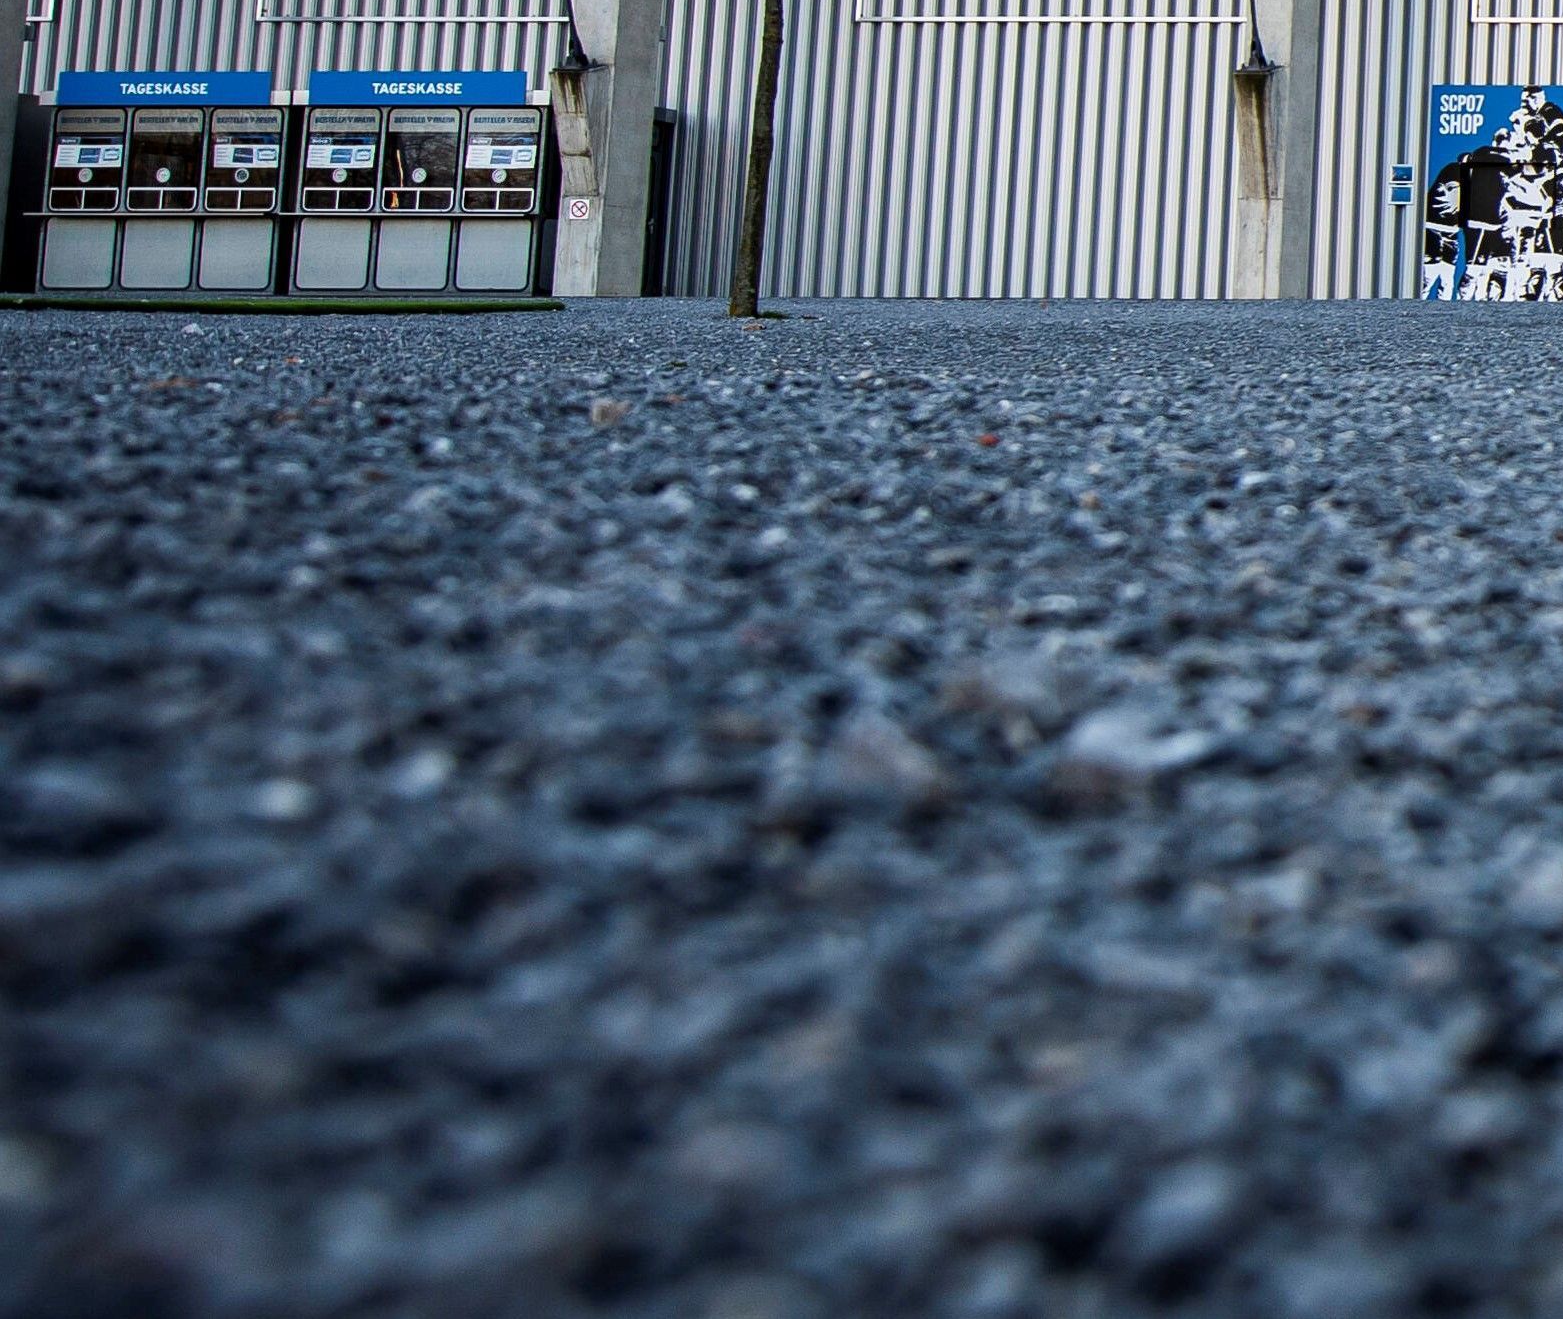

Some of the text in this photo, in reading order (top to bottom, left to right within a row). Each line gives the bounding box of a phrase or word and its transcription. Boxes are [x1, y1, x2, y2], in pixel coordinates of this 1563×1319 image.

[120, 82, 209, 95] TAGESKASSE
[372, 82, 463, 95] TAGESKASSE
[1439, 94, 1485, 112] SCP07
[1439, 114, 1484, 135] SHOP
